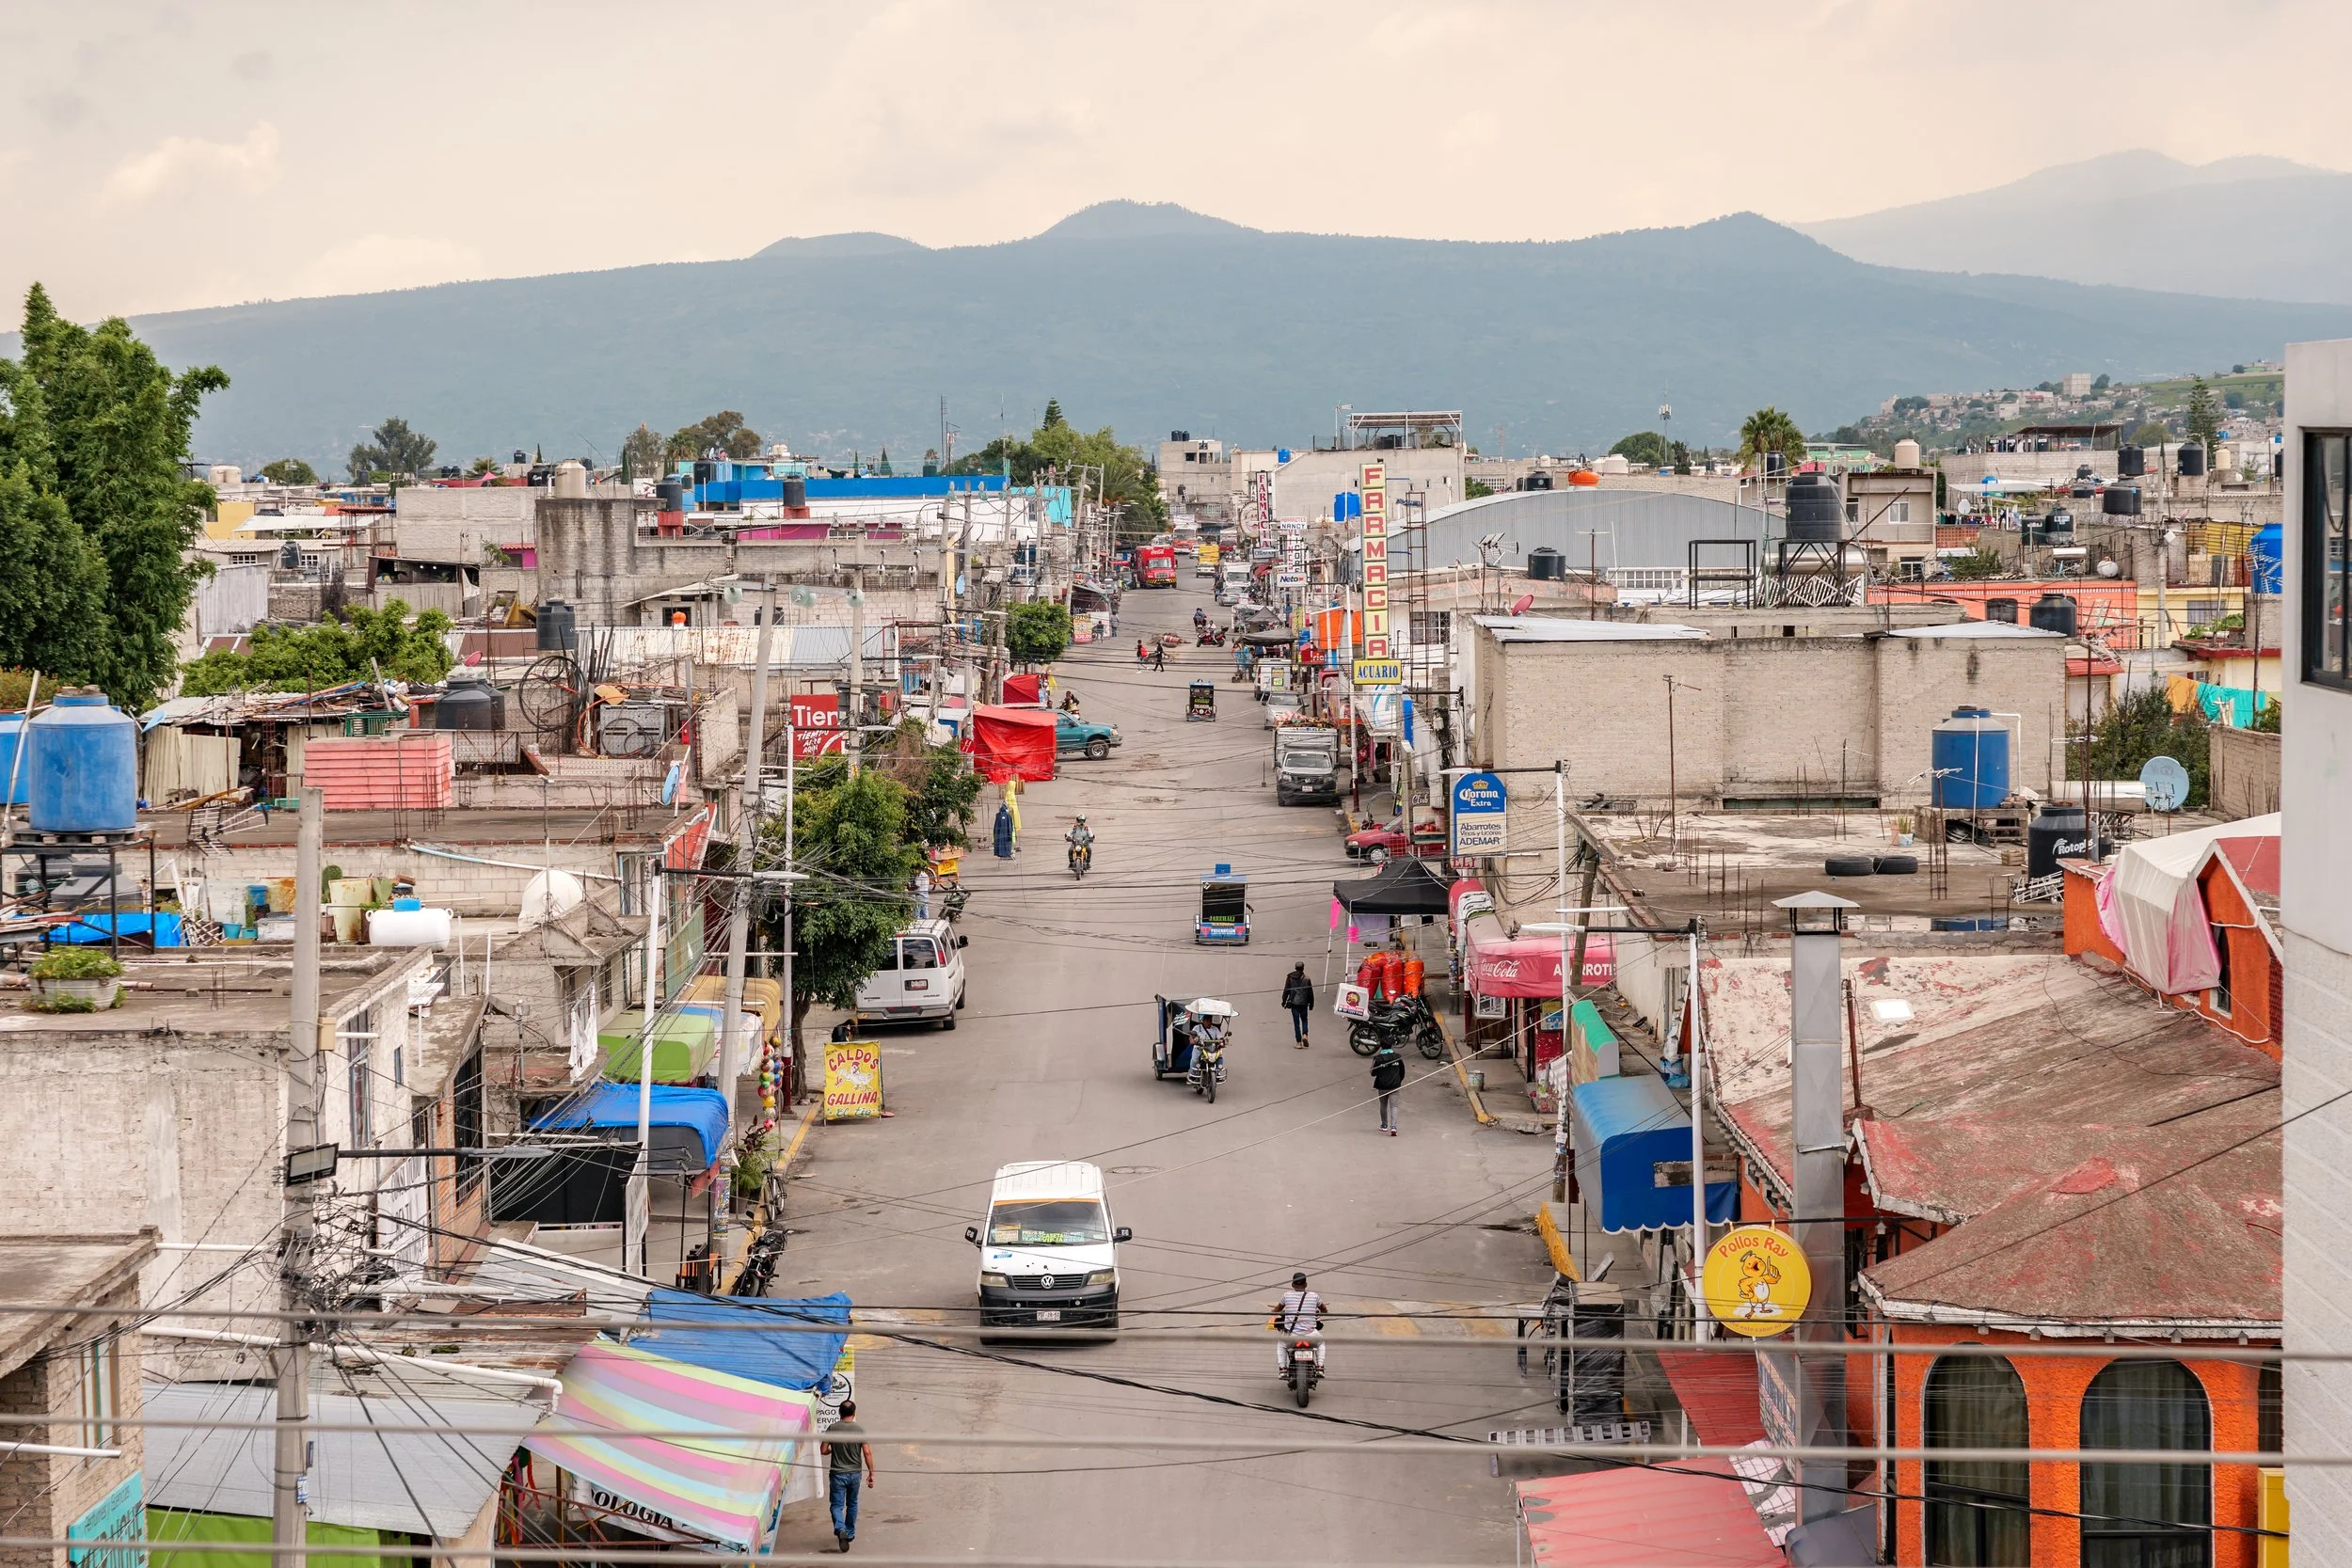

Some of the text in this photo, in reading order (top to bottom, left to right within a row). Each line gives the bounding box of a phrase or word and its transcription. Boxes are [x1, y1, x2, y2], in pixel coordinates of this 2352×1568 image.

[1258, 474, 1269, 547] FARMACIA
[1364, 467, 1387, 657] FARMACIA
[1357, 665, 1398, 679] ACUARIO
[1459, 787, 1500, 802] Corona
[1470, 799, 1492, 807] Extra
[1460, 822, 1501, 831] Abarrotes
[1459, 836, 1501, 846] ADEMAR
[2058, 838, 2094, 855] Rotopls
[828, 1048, 880, 1071] CALDOS
[827, 1091, 878, 1106] GALLINA
[1718, 1235, 1788, 1258] Pollos Ray
[592, 1491, 674, 1529] OLOGIA
